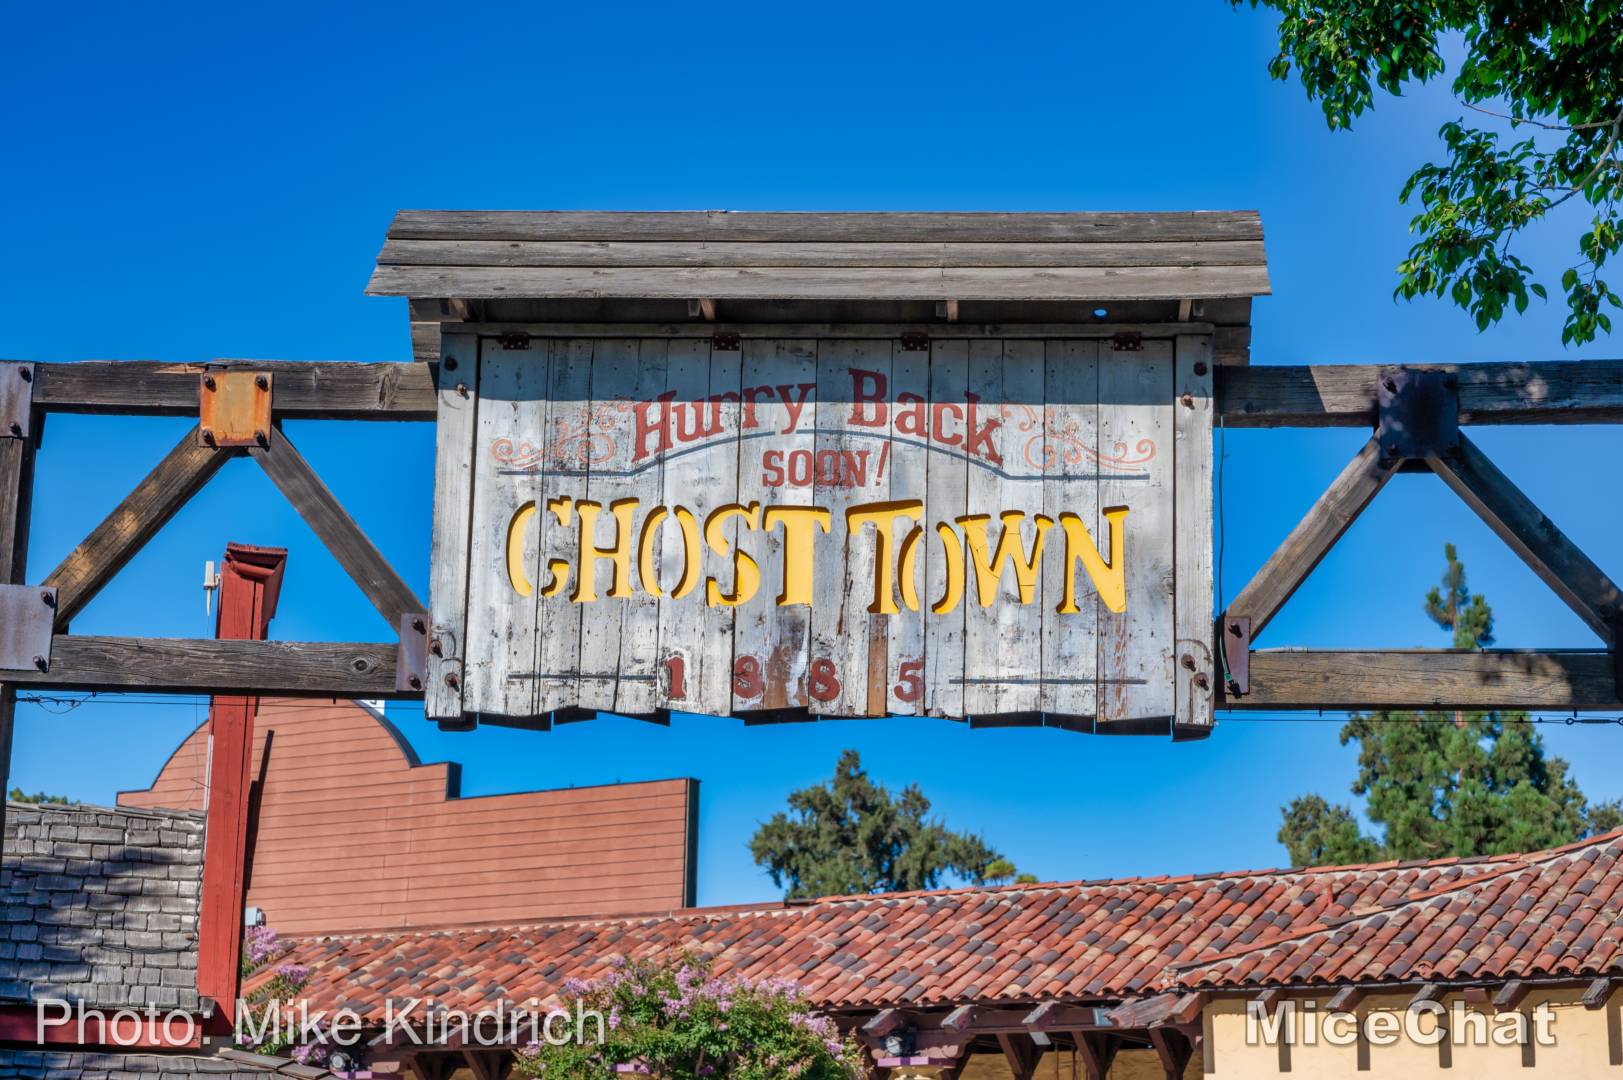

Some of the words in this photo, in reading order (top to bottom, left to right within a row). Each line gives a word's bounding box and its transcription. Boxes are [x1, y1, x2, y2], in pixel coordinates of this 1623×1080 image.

[631, 383, 816, 464] Hurry
[847, 367, 1004, 466] Back
[762, 441, 890, 488] SOON!
[505, 495, 833, 608] GHOST
[844, 498, 1130, 615] TOWN
